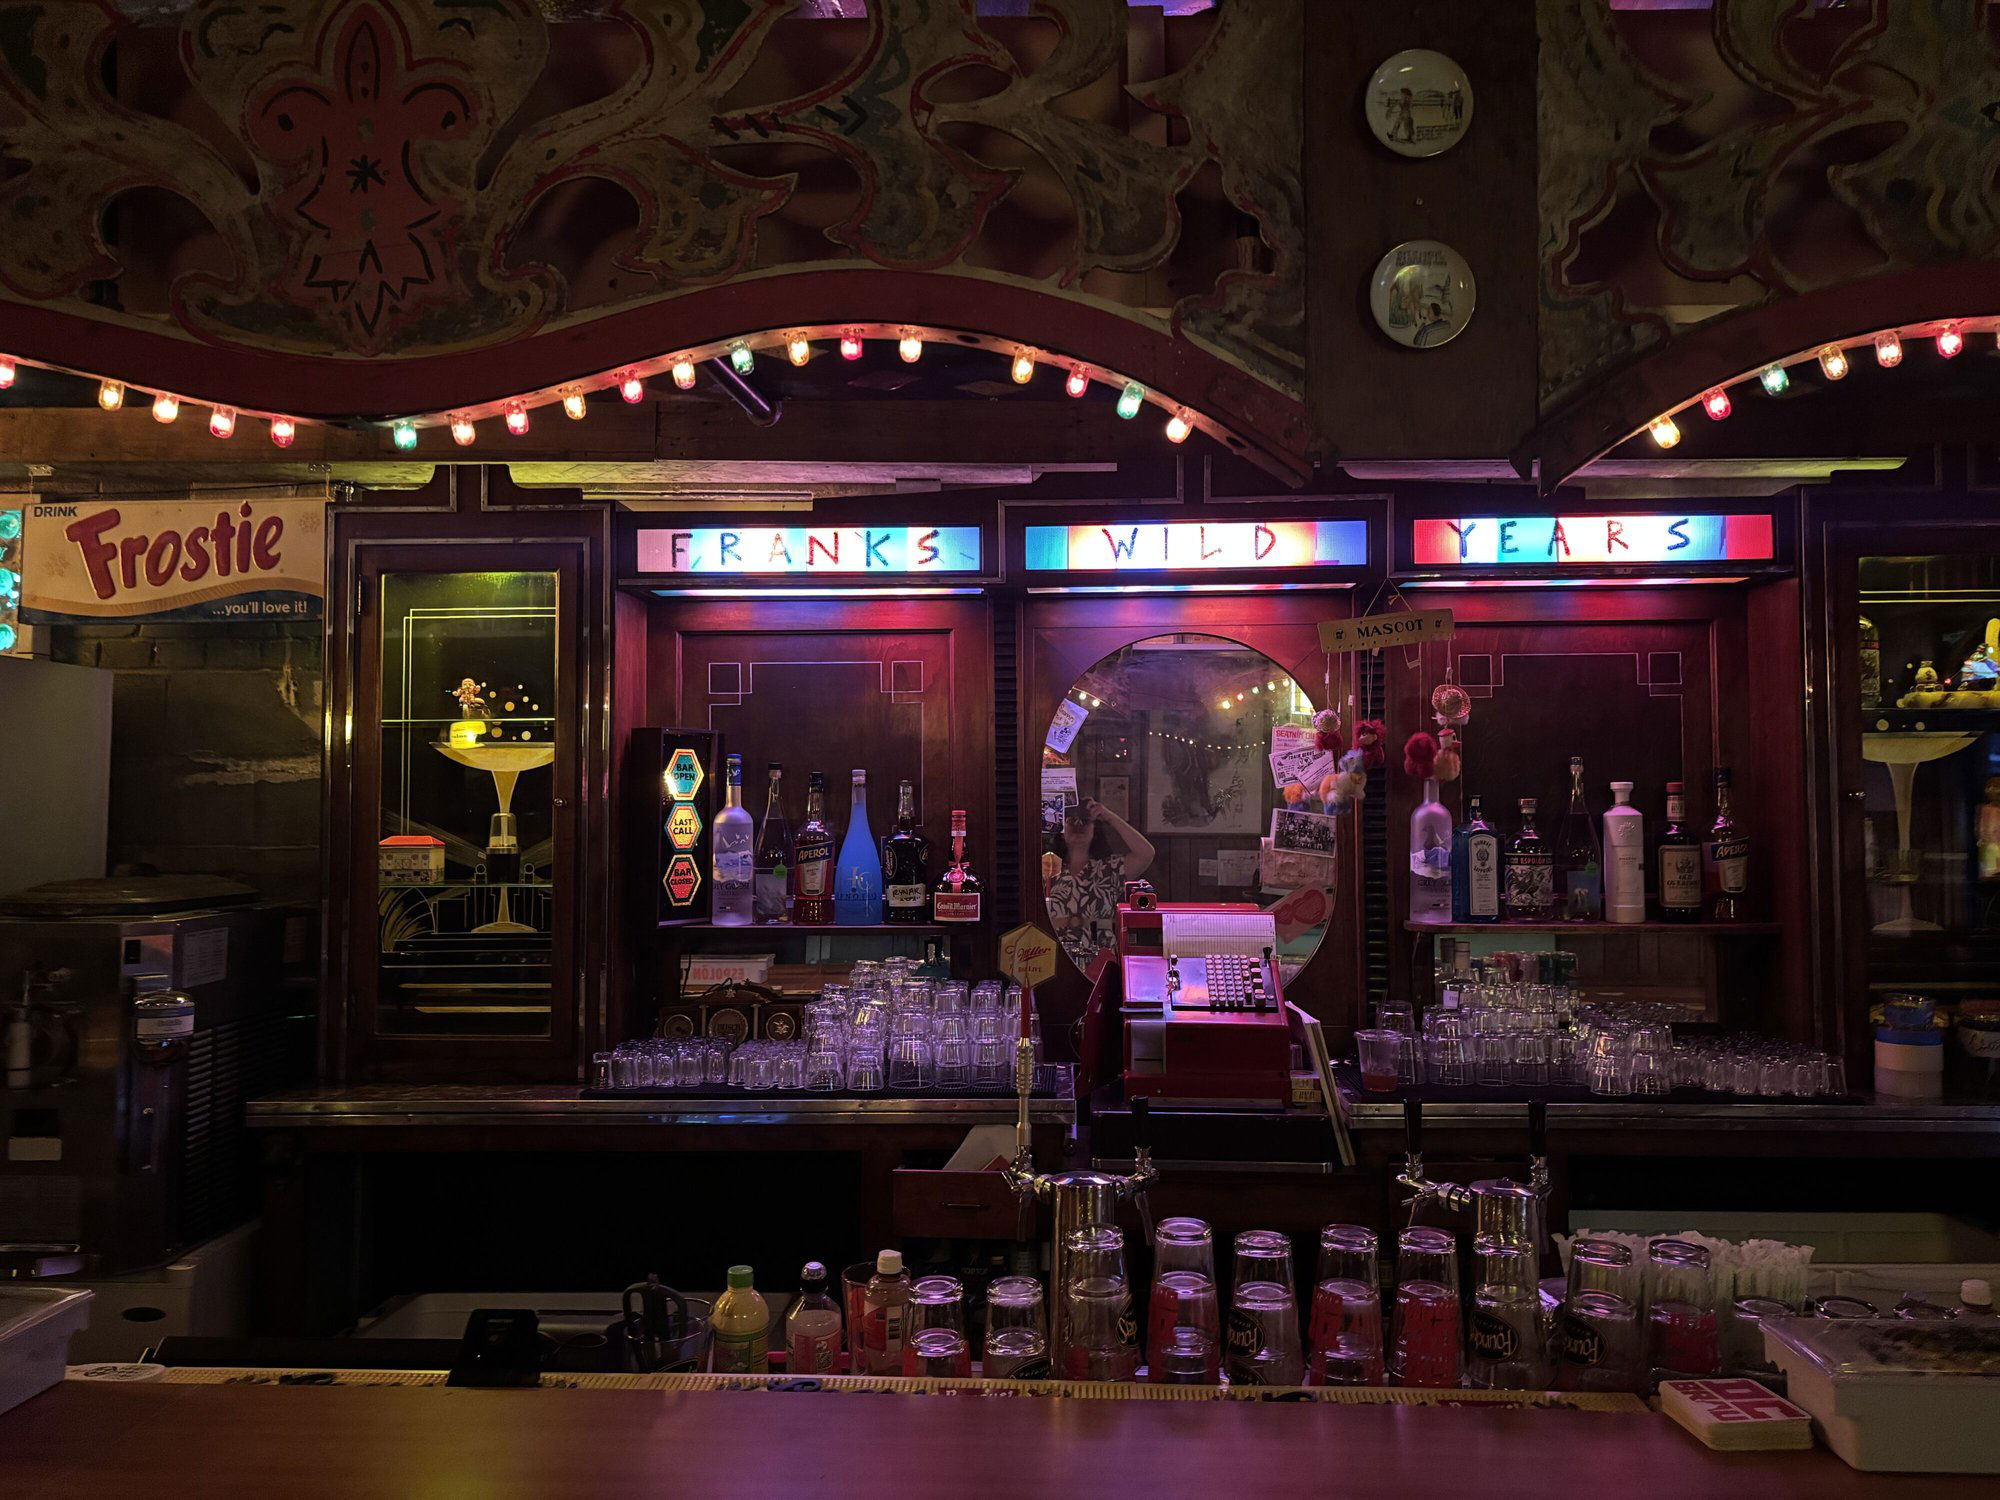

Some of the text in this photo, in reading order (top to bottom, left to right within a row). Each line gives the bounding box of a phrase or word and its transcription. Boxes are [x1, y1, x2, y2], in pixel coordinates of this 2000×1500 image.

[34, 506, 78, 518] DRINK
[1101, 525, 1277, 562] WILD
[1447, 518, 1690, 558] YEARS
[65, 500, 284, 600] Frostie
[671, 529, 940, 568] FRANKS
[212, 601, 308, 617] ...you'll love it!
[1357, 619, 1424, 638] MASCOT
[674, 773, 695, 781] OPEN
[673, 827, 694, 835] CALL
[798, 847, 830, 861] APEROL
[674, 868, 692, 876] BAR
